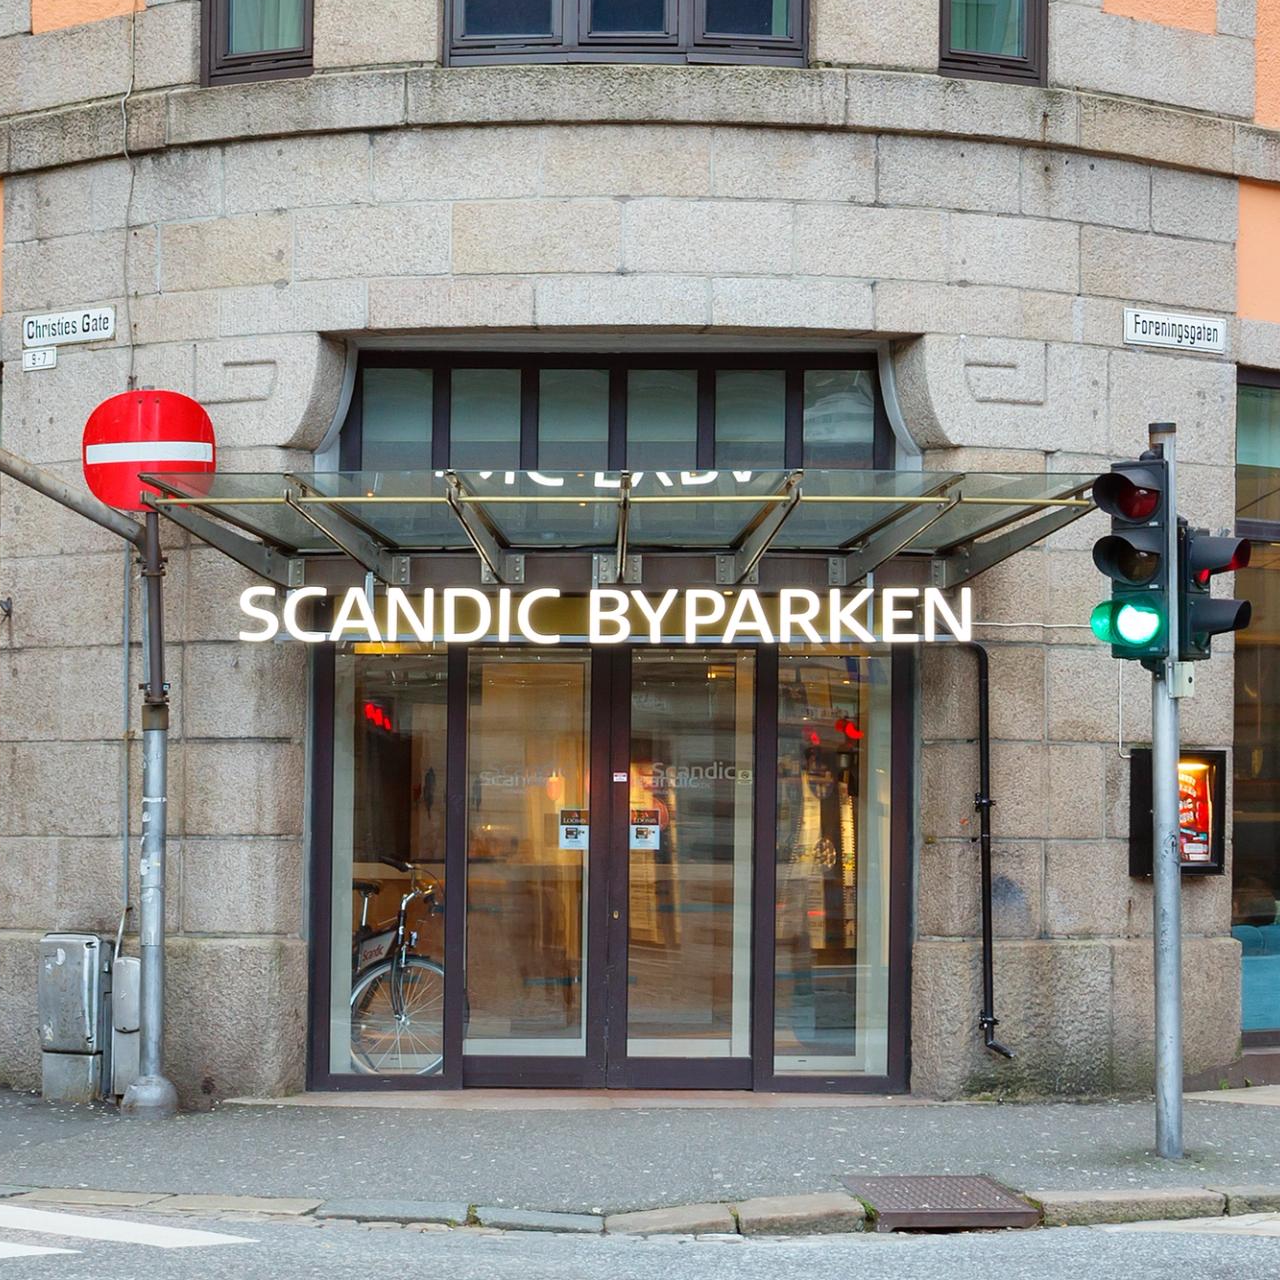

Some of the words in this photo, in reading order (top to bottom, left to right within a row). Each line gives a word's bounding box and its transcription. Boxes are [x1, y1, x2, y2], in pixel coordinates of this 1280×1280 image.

[27, 316, 77, 339] Christies
[82, 314, 109, 333] Gate
[1133, 314, 1219, 345] Foreningsgaten
[238, 585, 561, 644] SCANDIC
[589, 586, 972, 644] BYPARKEN
[652, 761, 736, 781] Scandic
